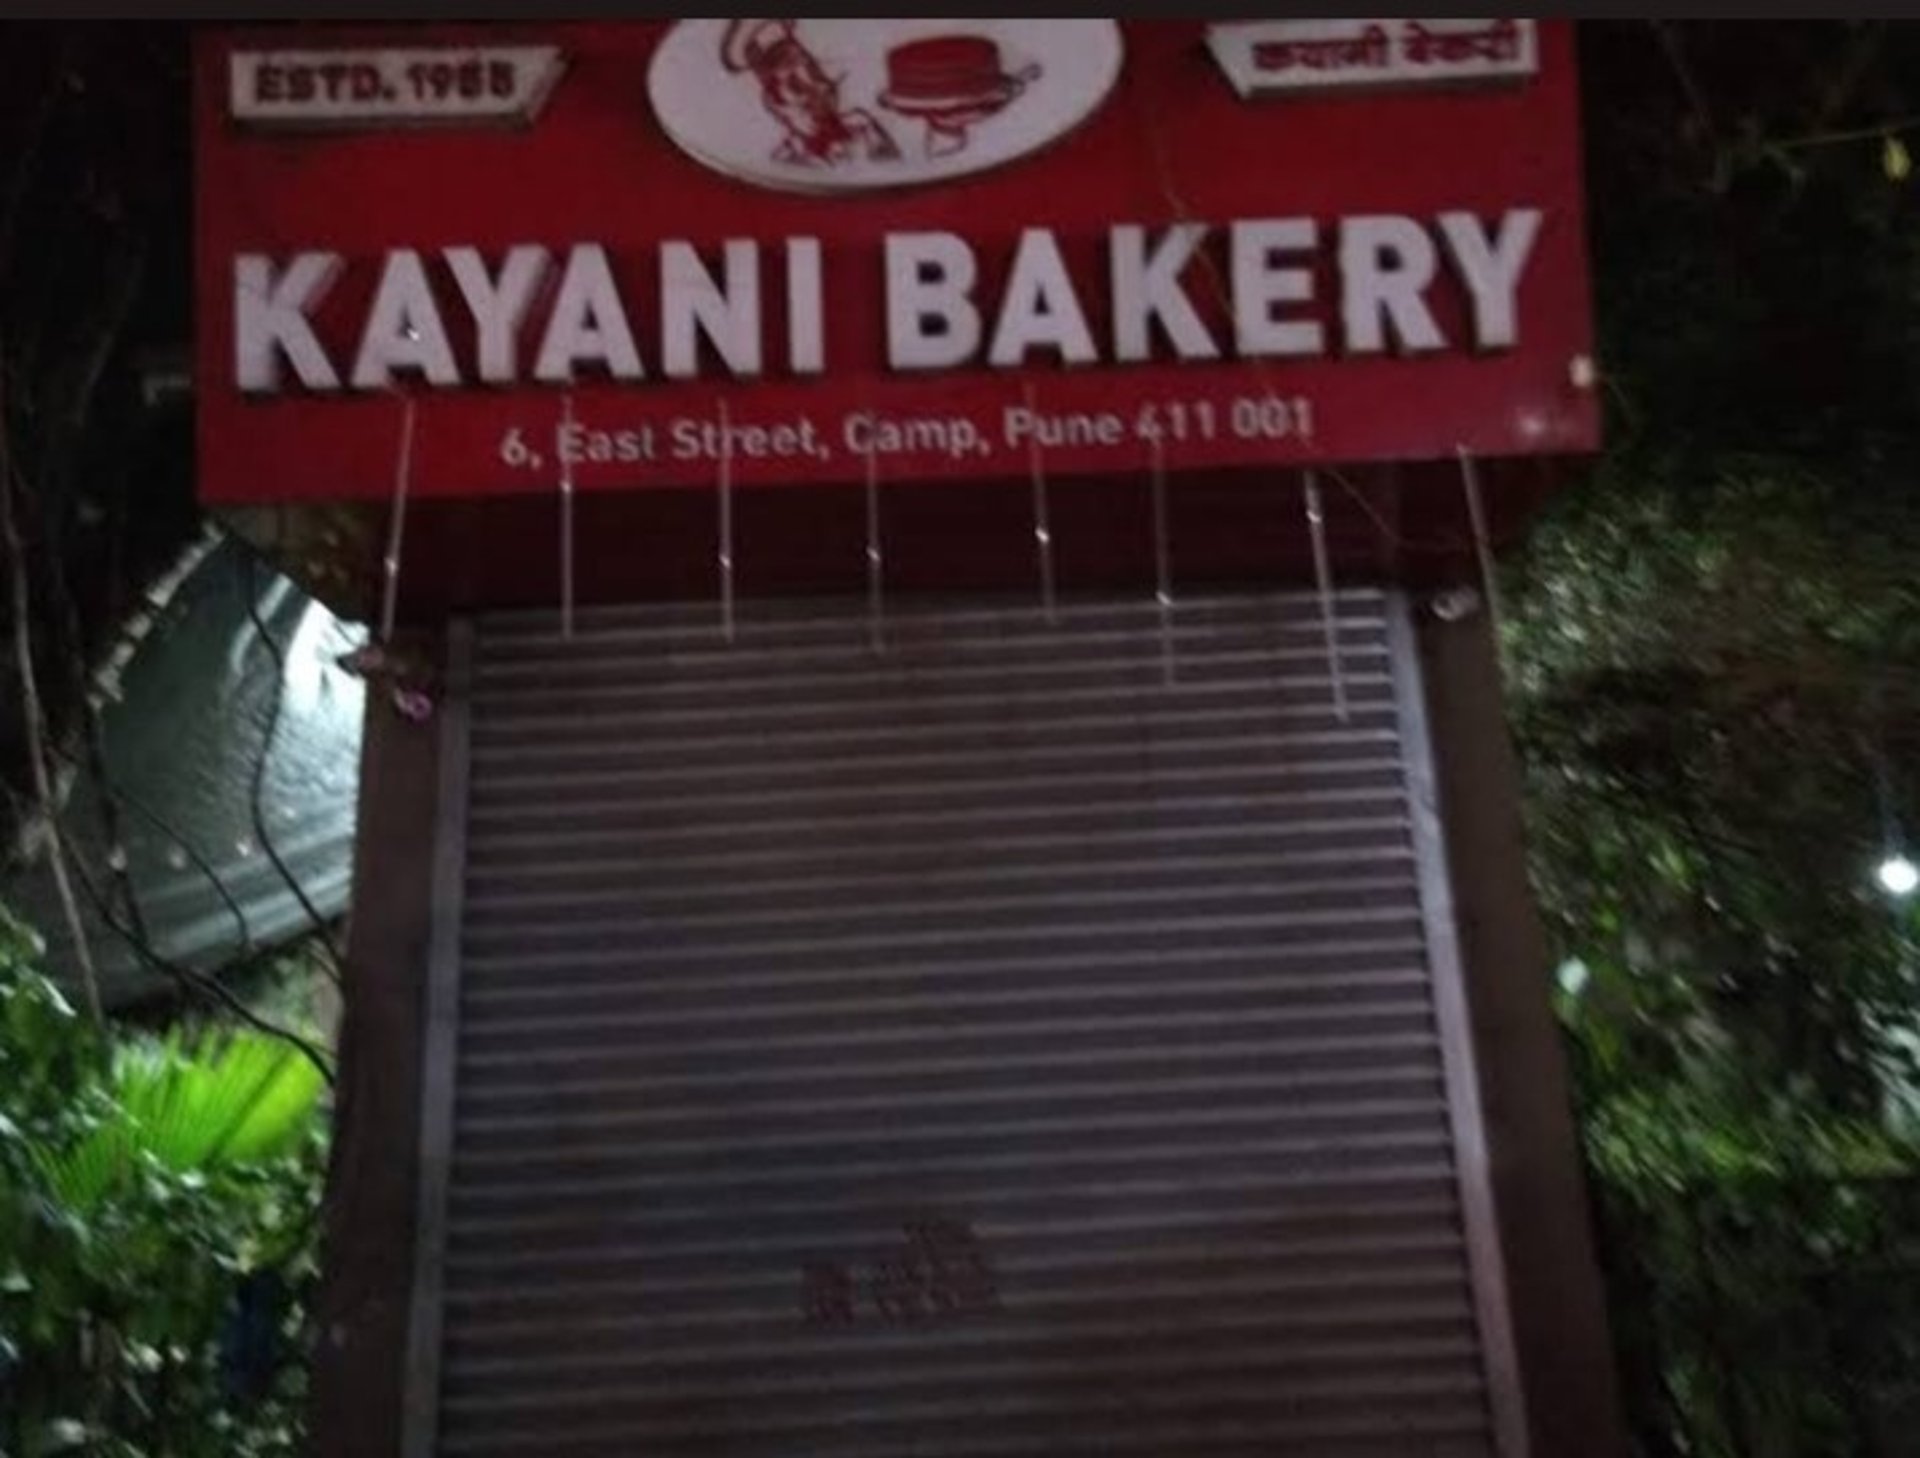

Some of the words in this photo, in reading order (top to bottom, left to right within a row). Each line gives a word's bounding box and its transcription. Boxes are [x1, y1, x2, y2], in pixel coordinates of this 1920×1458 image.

[255, 64, 397, 101] ESTD.
[233, 235, 824, 391] KAYANI
[884, 209, 1542, 369] BAKERY
[500, 429, 542, 469] 6,
[556, 422, 655, 463] East
[671, 418, 830, 461] Street,
[844, 413, 991, 459] Camp,
[1003, 405, 1123, 447] Pune
[1137, 400, 1215, 441] 411
[1232, 394, 1313, 438] 001
